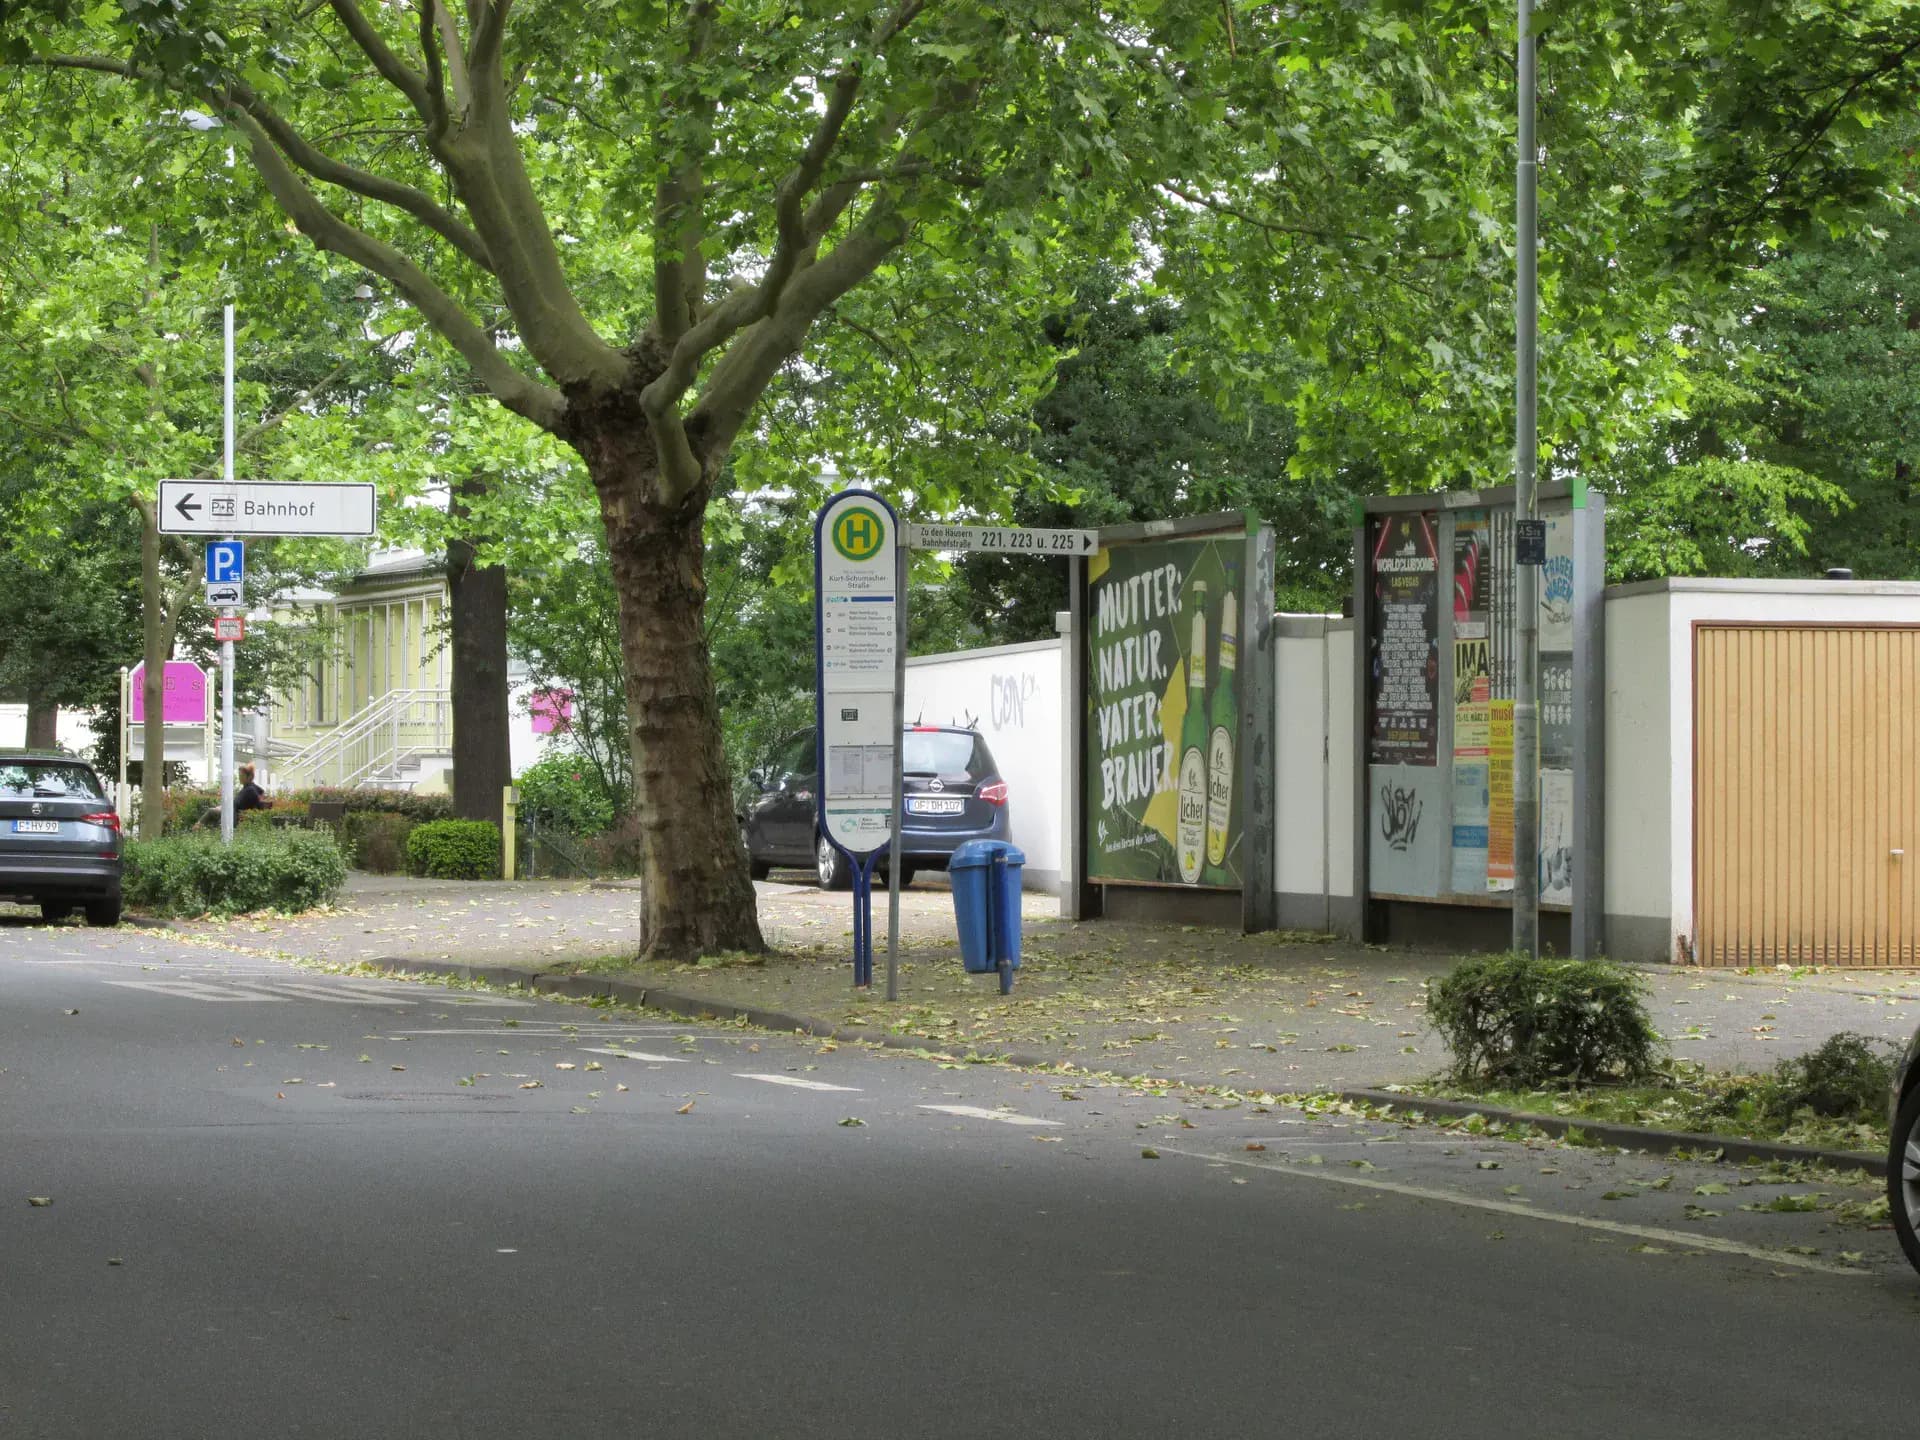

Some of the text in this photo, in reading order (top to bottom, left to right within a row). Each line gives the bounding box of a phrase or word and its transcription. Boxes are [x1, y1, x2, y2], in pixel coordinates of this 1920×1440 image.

[244, 501, 315, 516] Bahnhof
[846, 519, 870, 549] H
[922, 537, 971, 549] Bahnhofstraße
[930, 528, 943, 537] den
[1011, 533, 1032, 548] 223
[1052, 534, 1074, 549] 225
[215, 547, 234, 580] P
[1098, 563, 1182, 638] MUTTER:
[1099, 629, 1167, 693] NATUR.
[1099, 691, 1162, 750] VATER:
[1101, 740, 1179, 810] BRAUER.
[945, 802, 961, 811] 107
[1180, 793, 1204, 824] Licher
